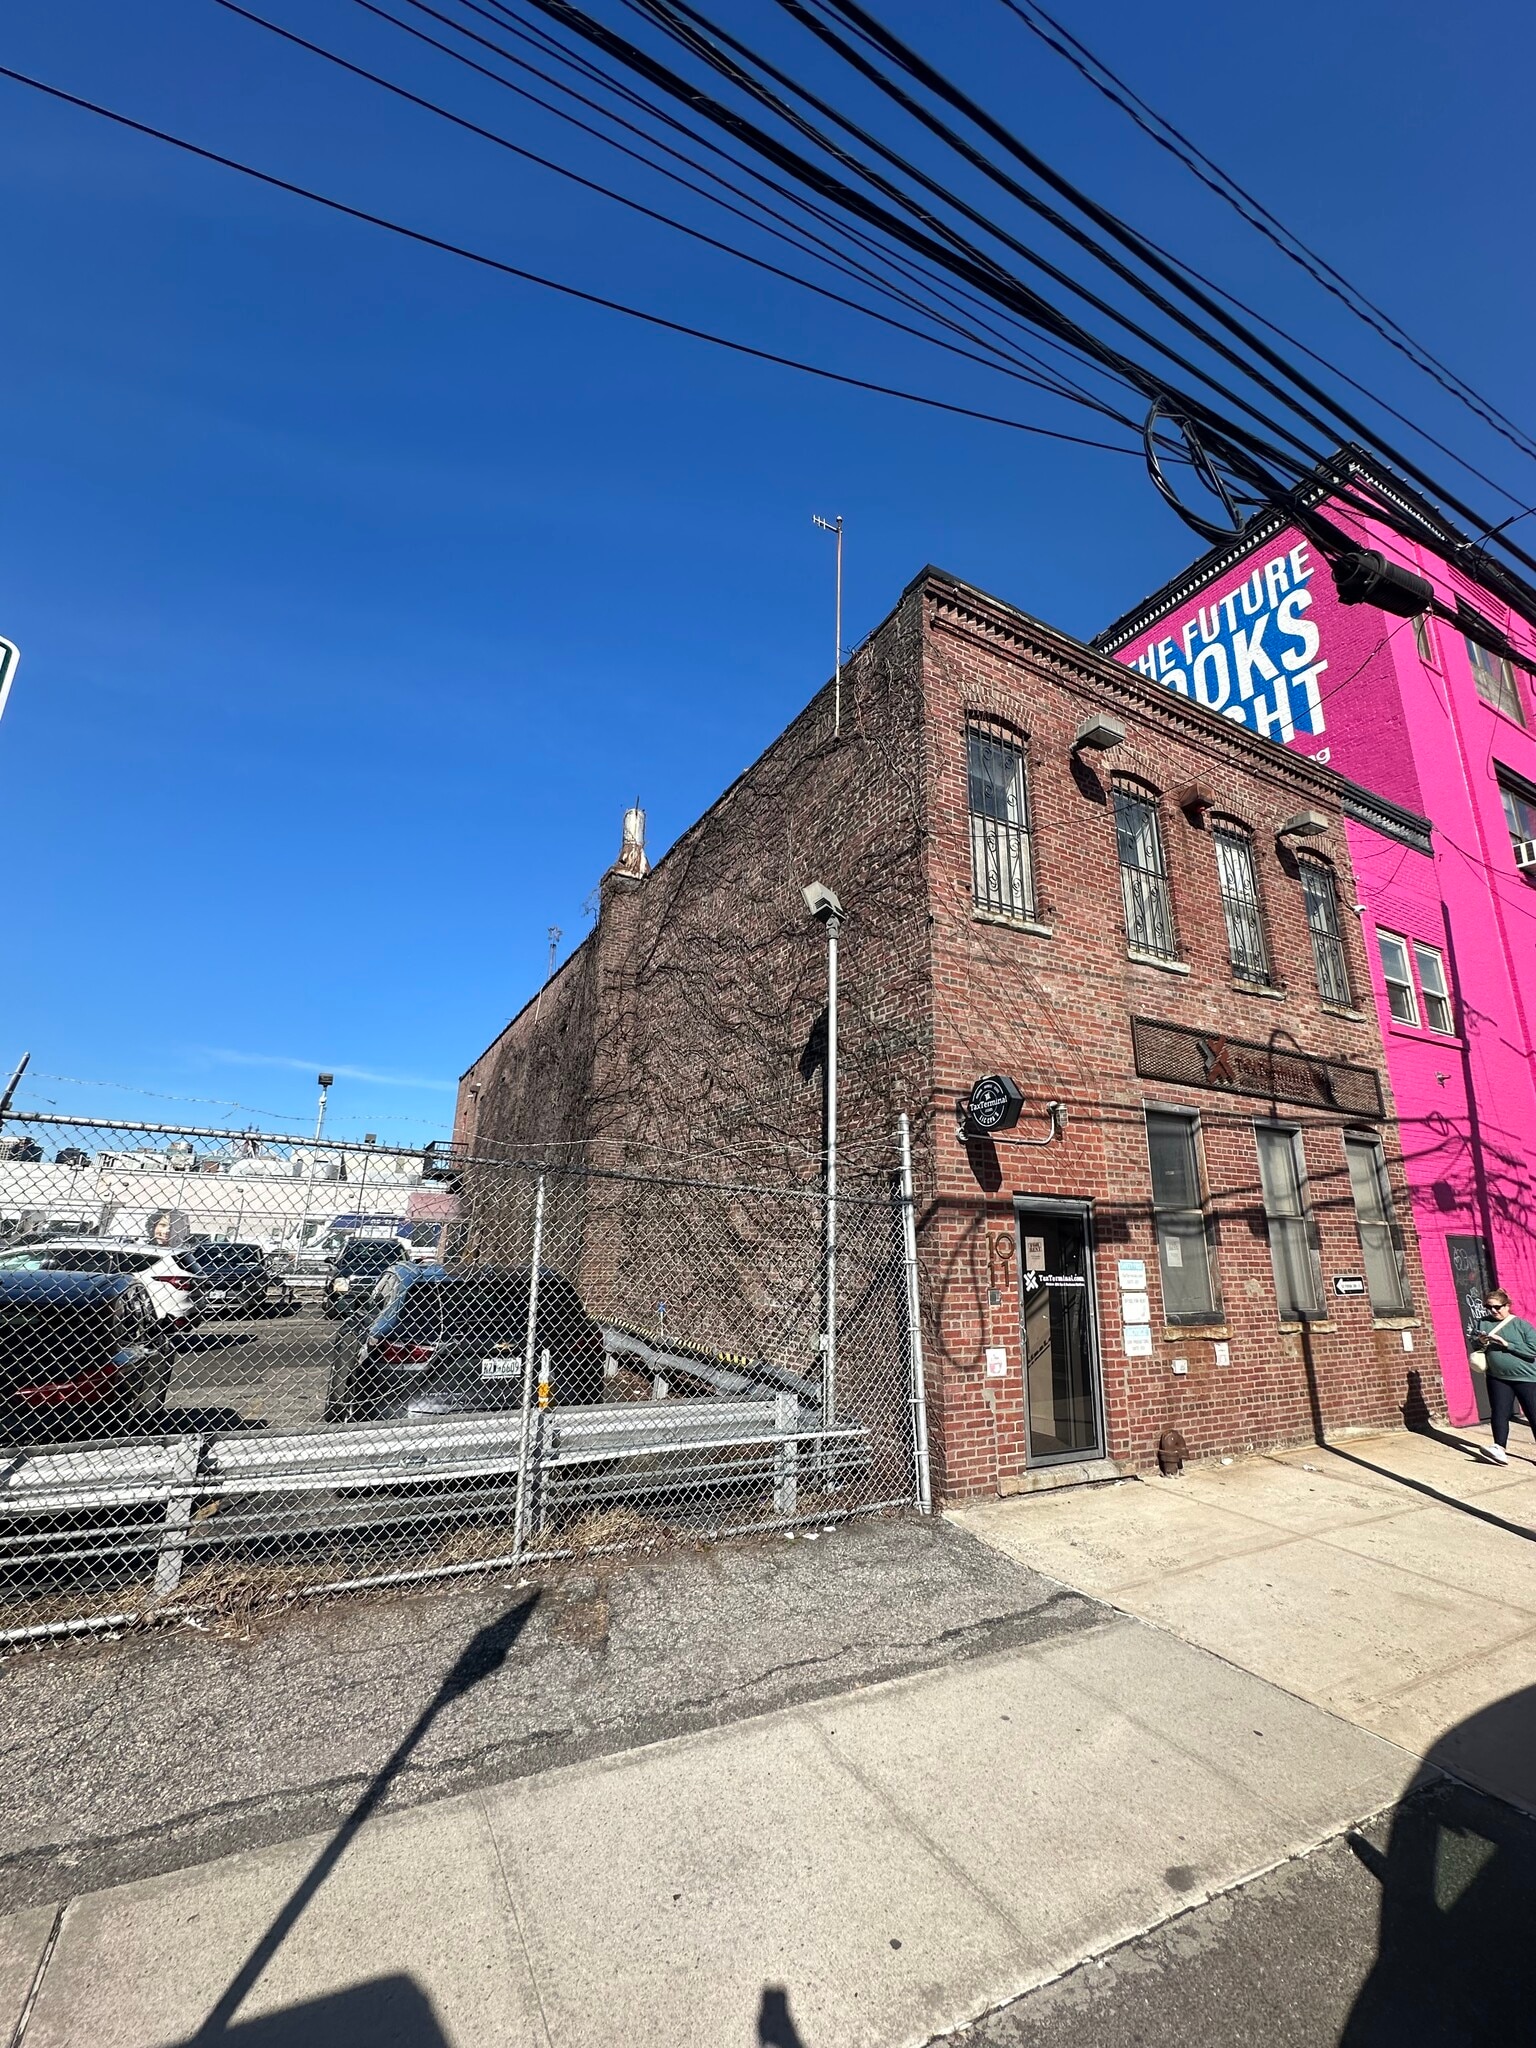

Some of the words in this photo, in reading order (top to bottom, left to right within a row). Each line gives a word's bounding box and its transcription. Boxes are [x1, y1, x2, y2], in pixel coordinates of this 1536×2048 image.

[1127, 637, 1176, 682] HE
[1182, 541, 1315, 665] FUTURE
[969, 1095, 1008, 1112] TaxTerminal
[985, 1231, 1015, 1260] 10
[987, 1261, 1010, 1288] 11
